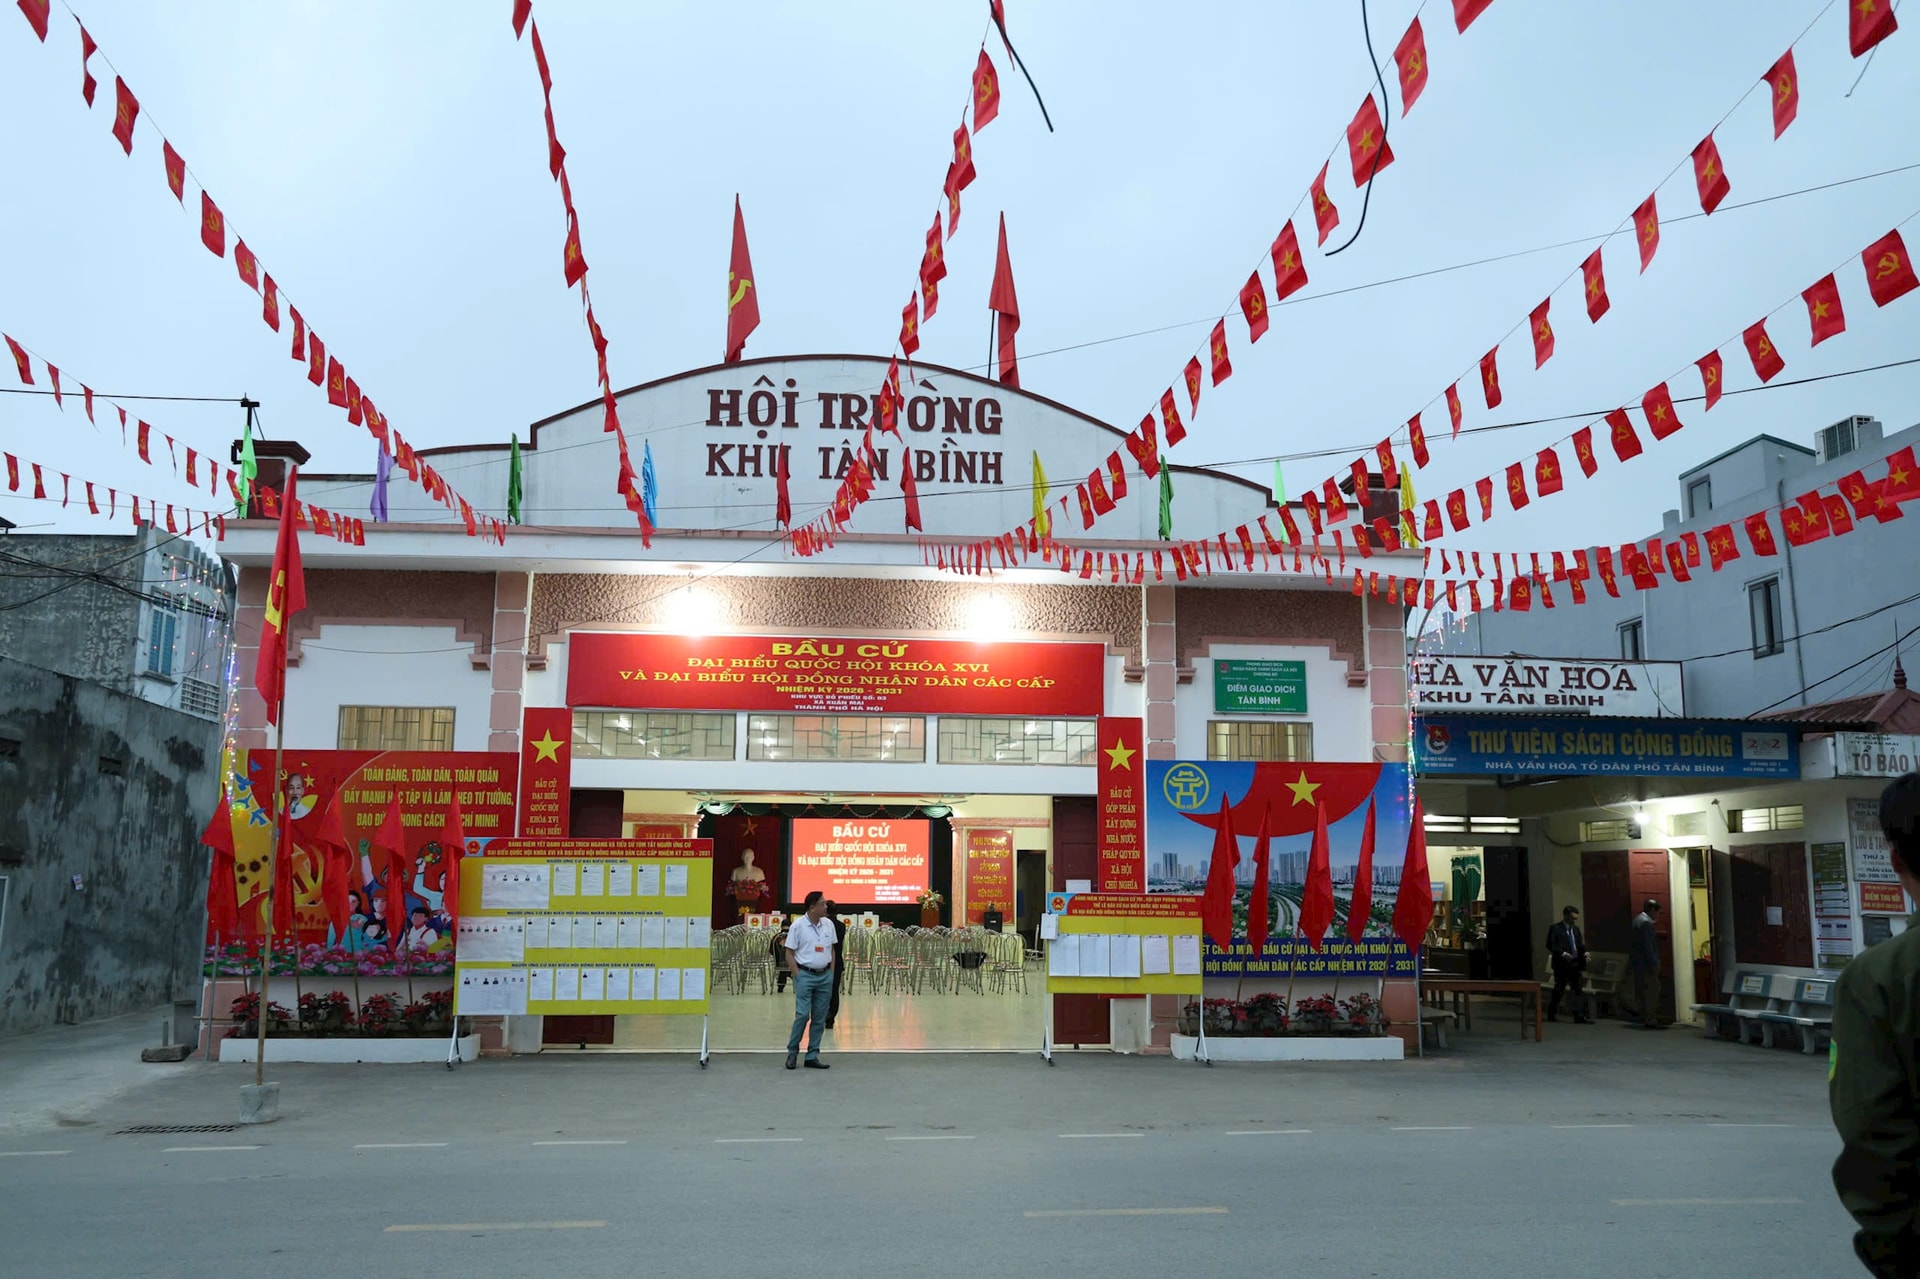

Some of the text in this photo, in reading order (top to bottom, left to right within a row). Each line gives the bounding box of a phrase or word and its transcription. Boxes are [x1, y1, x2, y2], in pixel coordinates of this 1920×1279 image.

[705, 375, 800, 439] HỘI
[705, 437, 1004, 485] KHU TÂN BÌNH
[771, 638, 909, 658] BẦU CỬ
[687, 654, 990, 673] ĐẠI BIỂU QUỐC HỘI KHÓA XVI
[1414, 658, 1463, 685] HÀ
[1473, 660, 1549, 688] VĂN
[618, 668, 1056, 689] VÀ ĐẠI BIỂU HỘI ĐỒNG NHÂN DÂN CÁC CẤP
[776, 685, 815, 693] NHIỆM
[836, 686, 864, 694] 2026
[1226, 683, 1296, 694] ĐIỂM GIAO DỊCH
[1419, 687, 1604, 706] KHU TÂN BÌNH
[1238, 695, 1281, 705] TÂN BÌNH
[1468, 729, 1507, 753] THƯ
[1511, 727, 1556, 759] VIỆN
[1562, 728, 1615, 756] SÁCH
[1620, 728, 1674, 760] CỘNG
[1485, 759, 1725, 773] NHÀ VĂN HÓA TỔ DÂN PHỐ TÂN BÌNH
[1851, 745, 1872, 772] TỔ
[1876, 747, 1909, 773] BẢO
[363, 765, 384, 781] TOÀN
[411, 766, 432, 782] TOÀN
[454, 766, 476, 783] TOÀN
[477, 766, 499, 784] QUÂN
[361, 790, 385, 806] MẠNH
[387, 790, 403, 805] HC
[405, 788, 421, 808] TẬP
[422, 788, 433, 805] VÀ
[434, 788, 452, 805] LÀM
[457, 791, 473, 805] HEO
[474, 790, 485, 805] TƯ
[356, 812, 373, 830] ĐẠO
[401, 813, 422, 827] HONG
[424, 811, 446, 827] CÁCH
[832, 821, 891, 838] BẦU CỬ
[1394, 943, 1407, 954] XVI
[1246, 959, 1270, 972] NHÂN
[1272, 959, 1289, 972] DÂN
[1396, 960, 1415, 970] 2031
